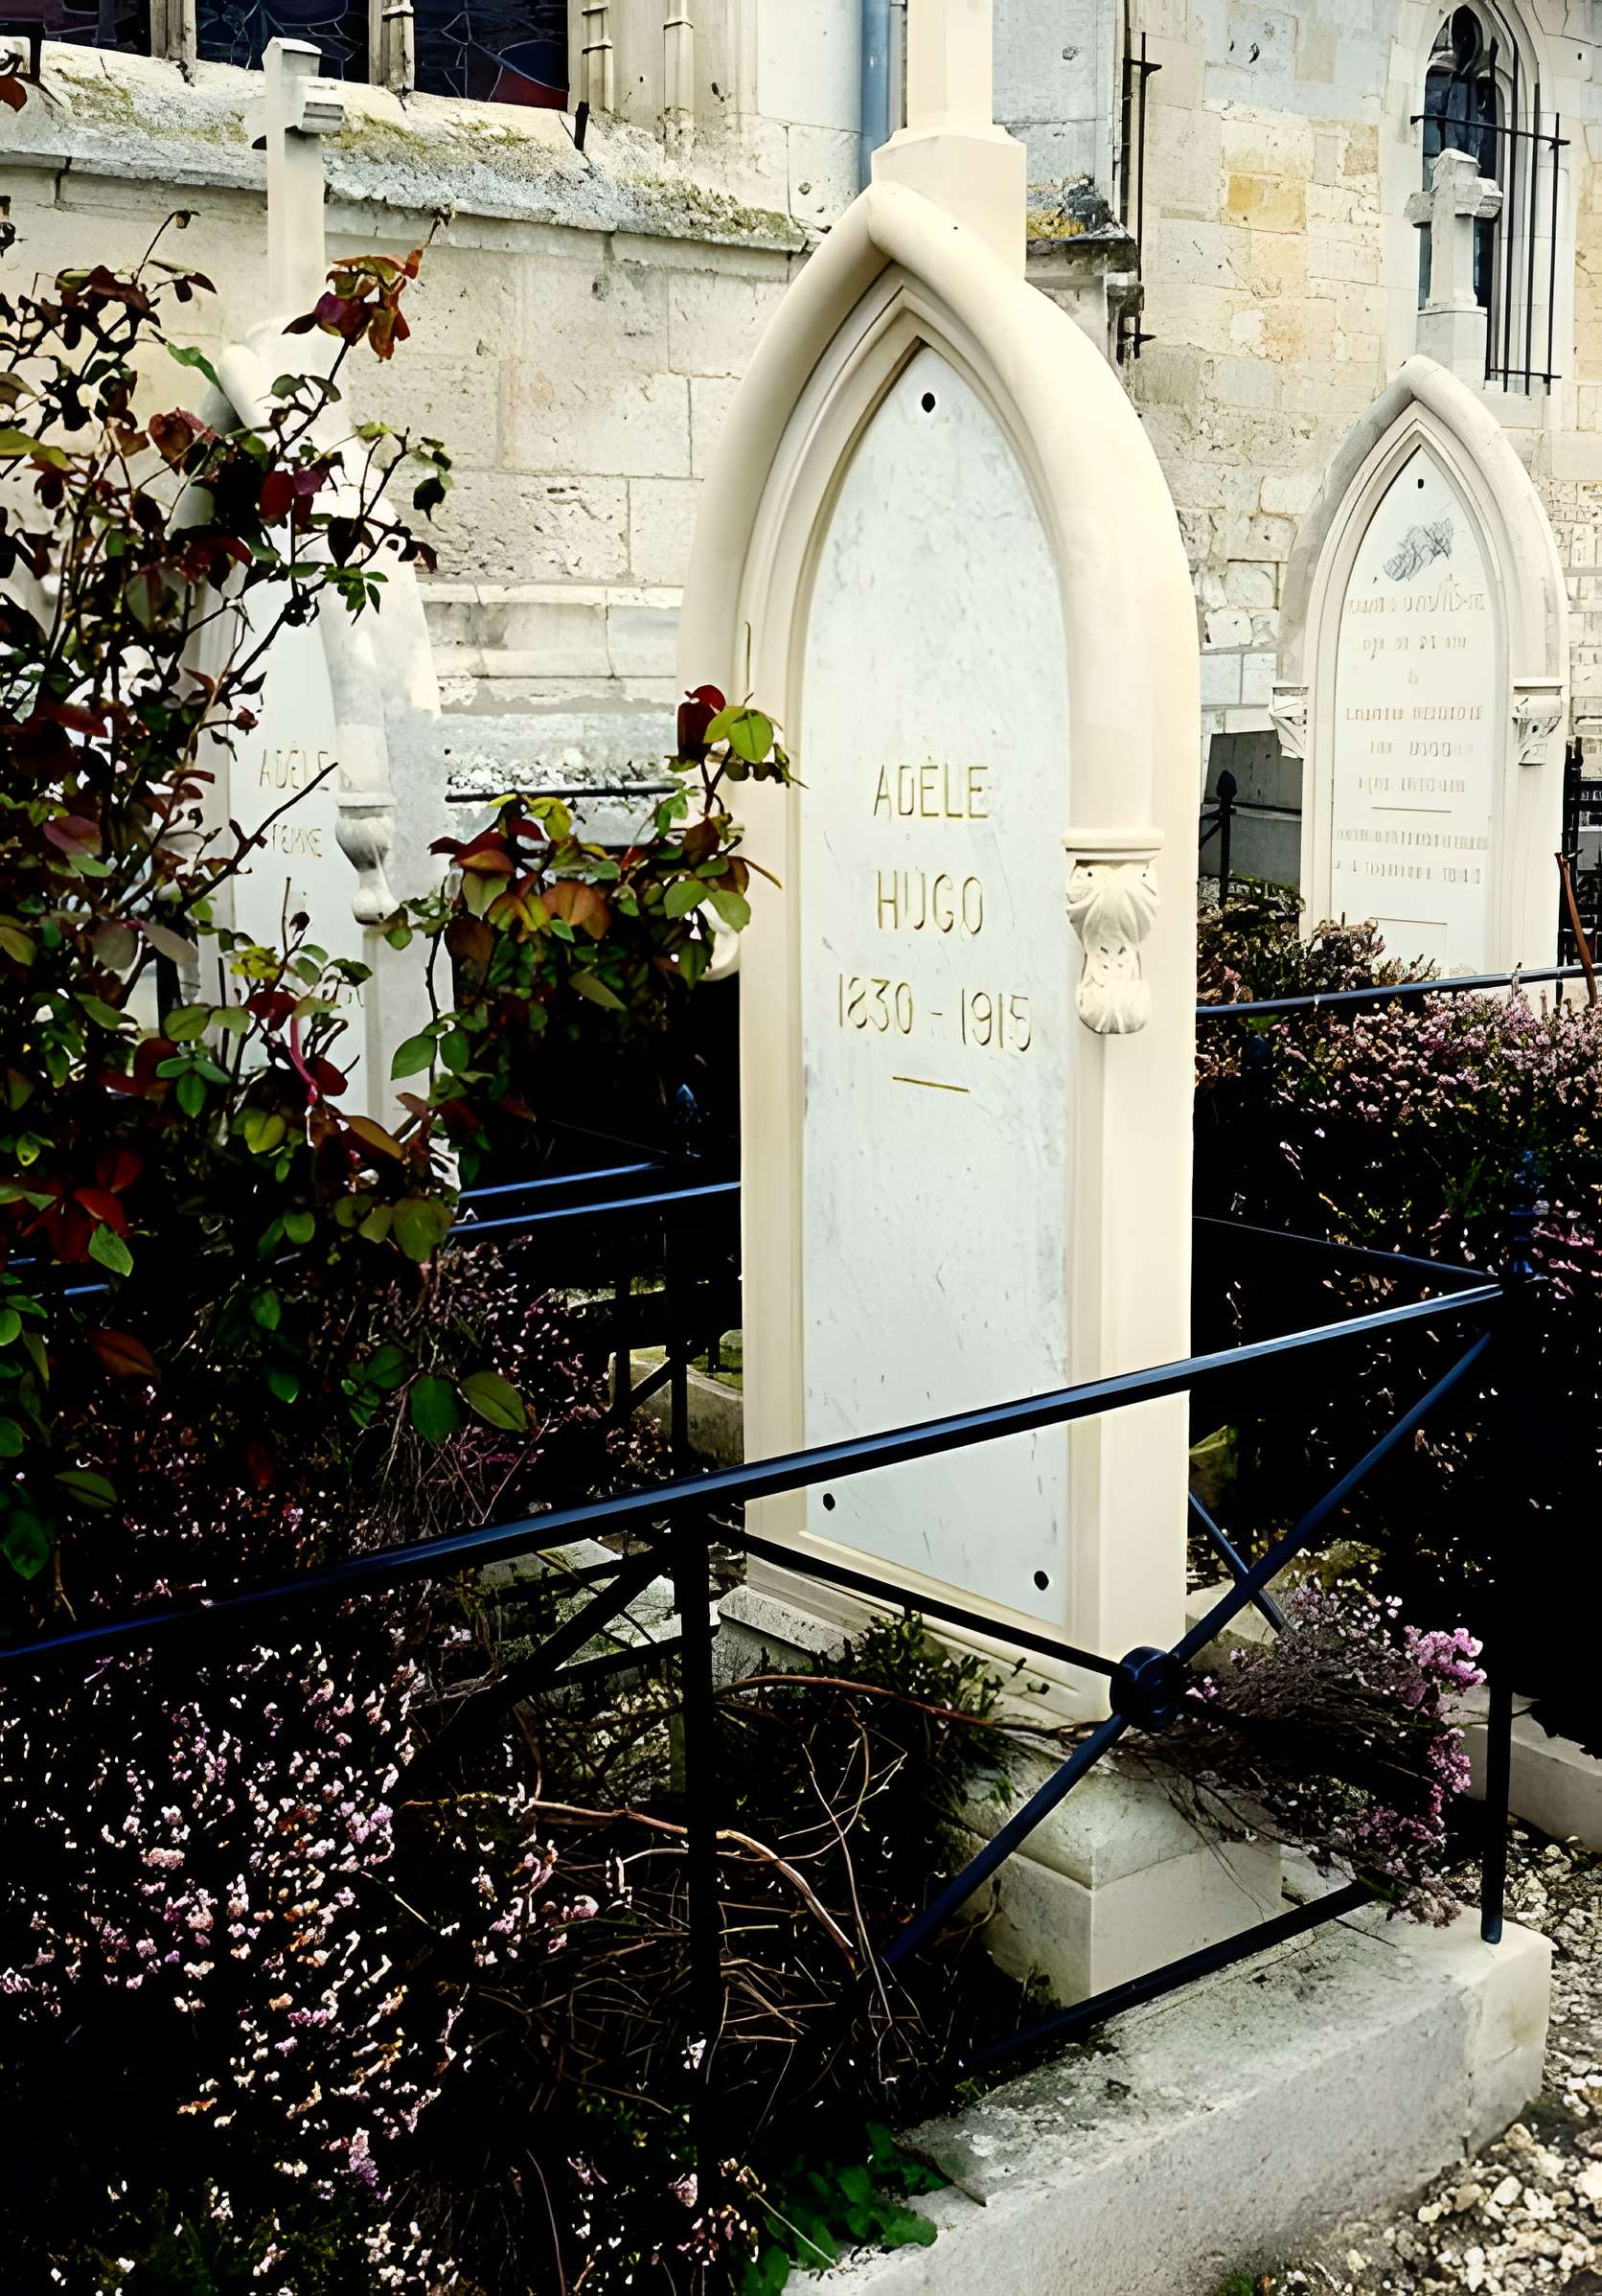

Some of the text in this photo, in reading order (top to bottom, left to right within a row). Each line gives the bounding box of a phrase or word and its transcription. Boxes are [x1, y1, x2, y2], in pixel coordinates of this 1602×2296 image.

[877, 867, 984, 935] HUGO
[838, 973, 913, 1035] 1830
[960, 987, 1033, 1052] 1915
